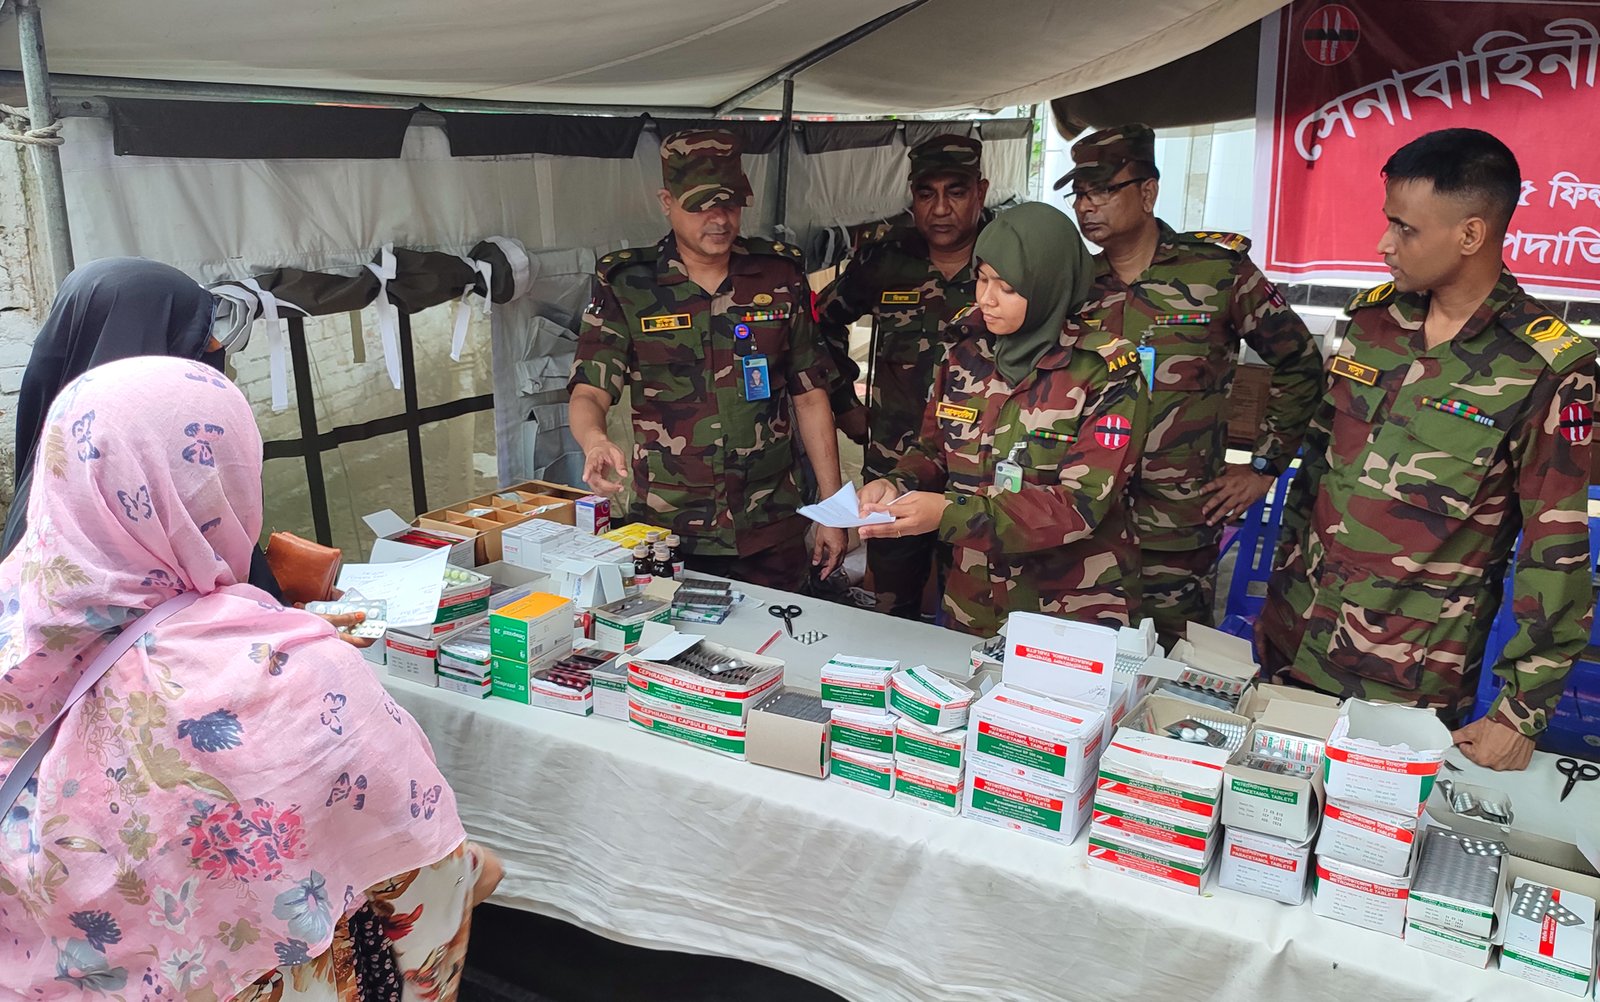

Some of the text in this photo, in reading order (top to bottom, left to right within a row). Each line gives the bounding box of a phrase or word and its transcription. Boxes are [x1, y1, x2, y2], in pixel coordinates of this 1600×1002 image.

[1294, 18, 1600, 161] সেনাবাহিনী
[1026, 648, 1093, 666] PARACETAMOL TABLETS
[638, 668, 673, 684] CEPHRADINE
[674, 680, 702, 692] CAPSULE
[641, 707, 677, 722] CEPHRADINE
[678, 717, 705, 730] CAPSULE
[988, 730, 1055, 753] PARACETAMOL TABLETS
[983, 786, 1051, 808] PARACETAMOL TABLETS
[1233, 786, 1294, 803] PARACETAMOL TABLETS
[1232, 851, 1293, 870] PARACETAMOL TABLETS
